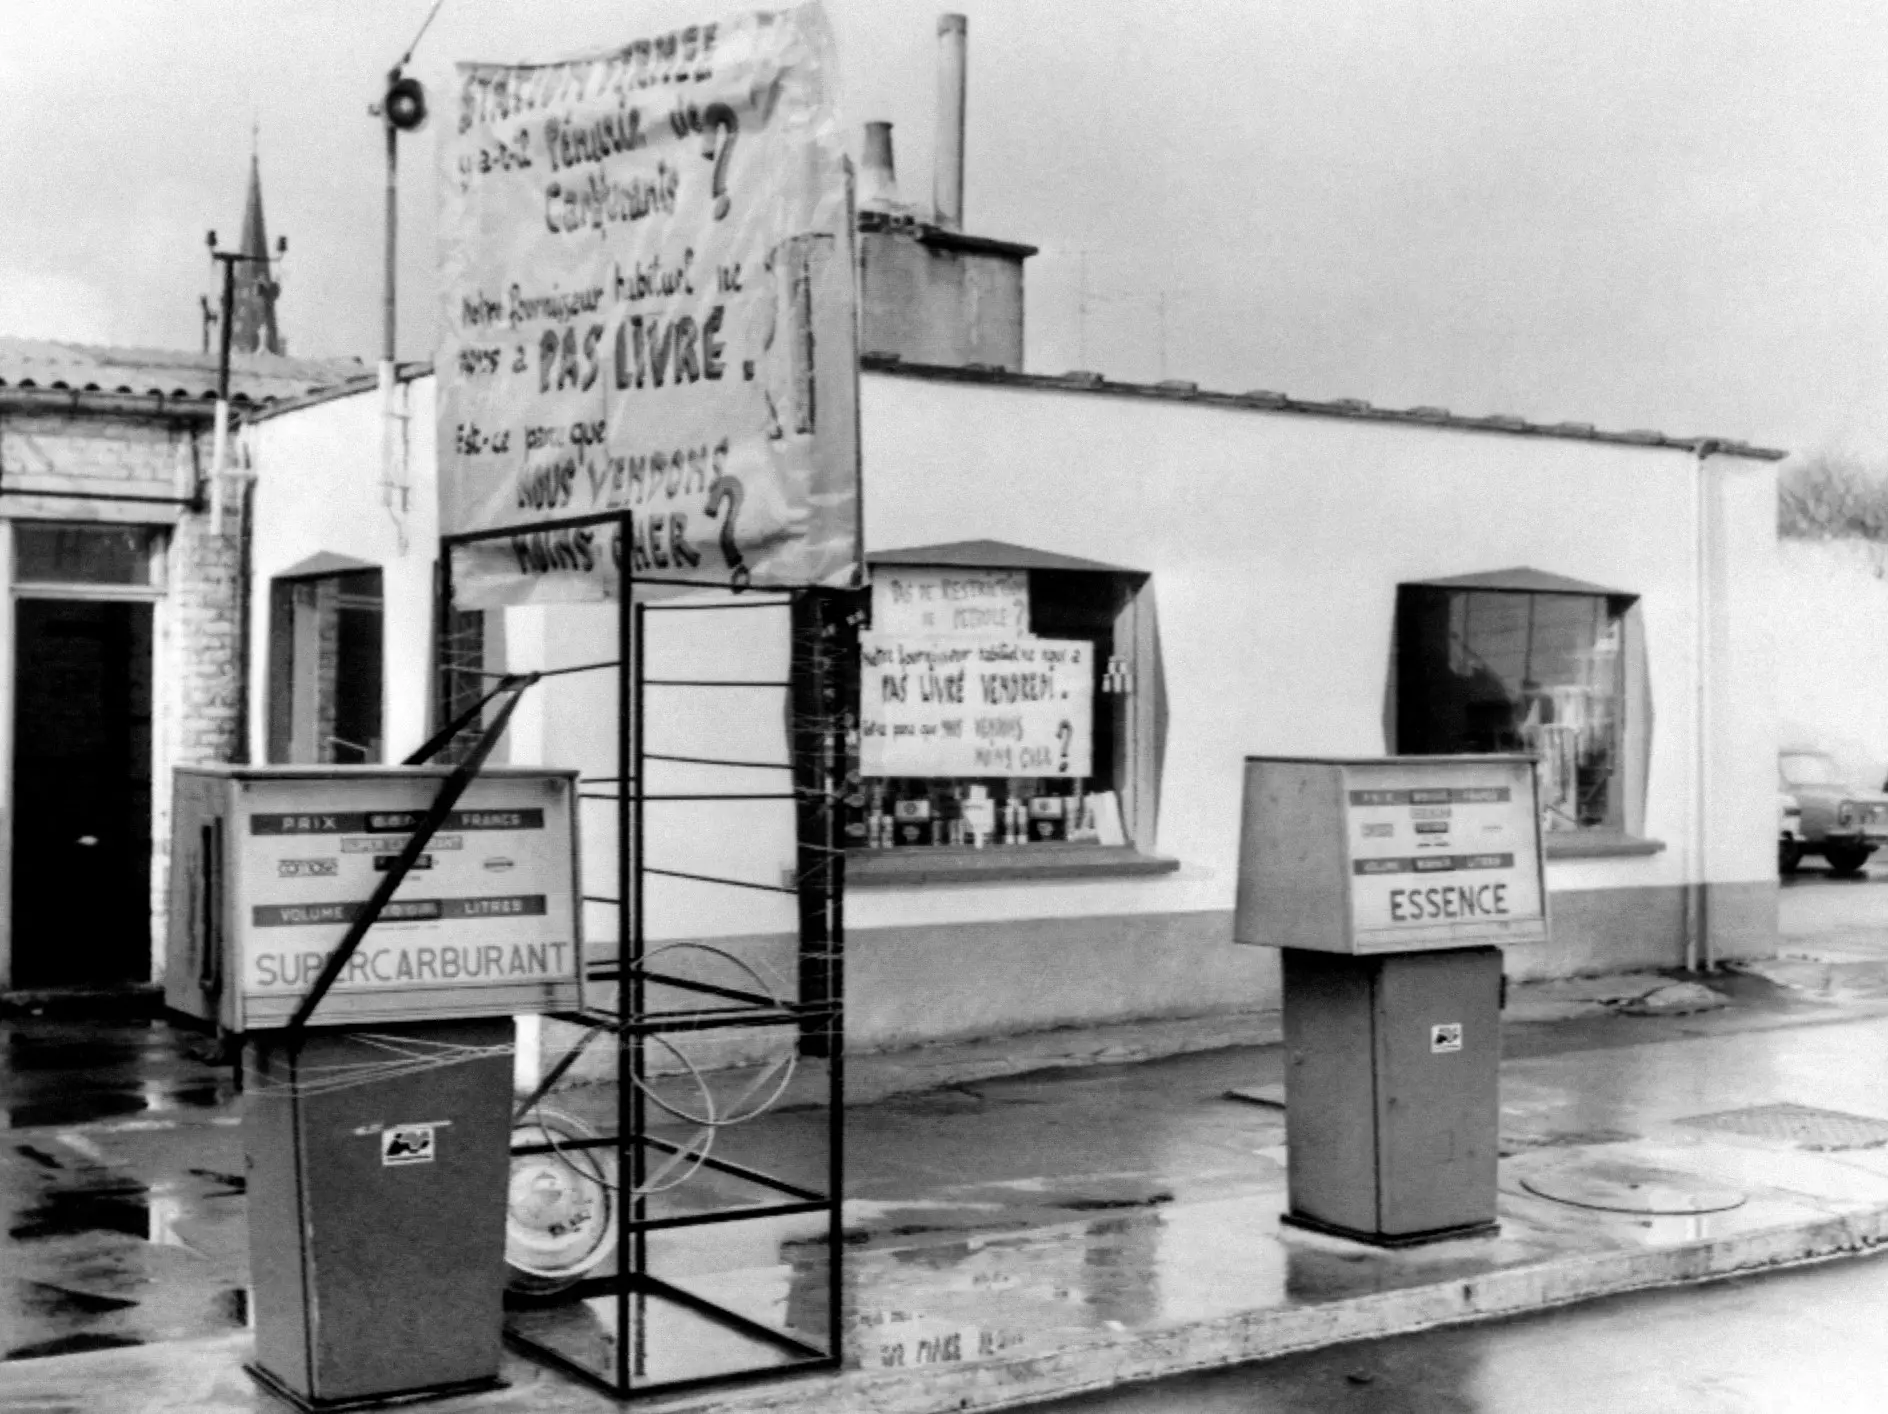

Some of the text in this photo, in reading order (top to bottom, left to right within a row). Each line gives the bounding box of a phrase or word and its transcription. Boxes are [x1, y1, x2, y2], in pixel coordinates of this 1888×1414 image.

[540, 322, 604, 394] PAS
[281, 815, 338, 830] PRIX
[280, 897, 523, 922] VOLUME LITRES
[1390, 883, 1510, 922] ESSENCE
